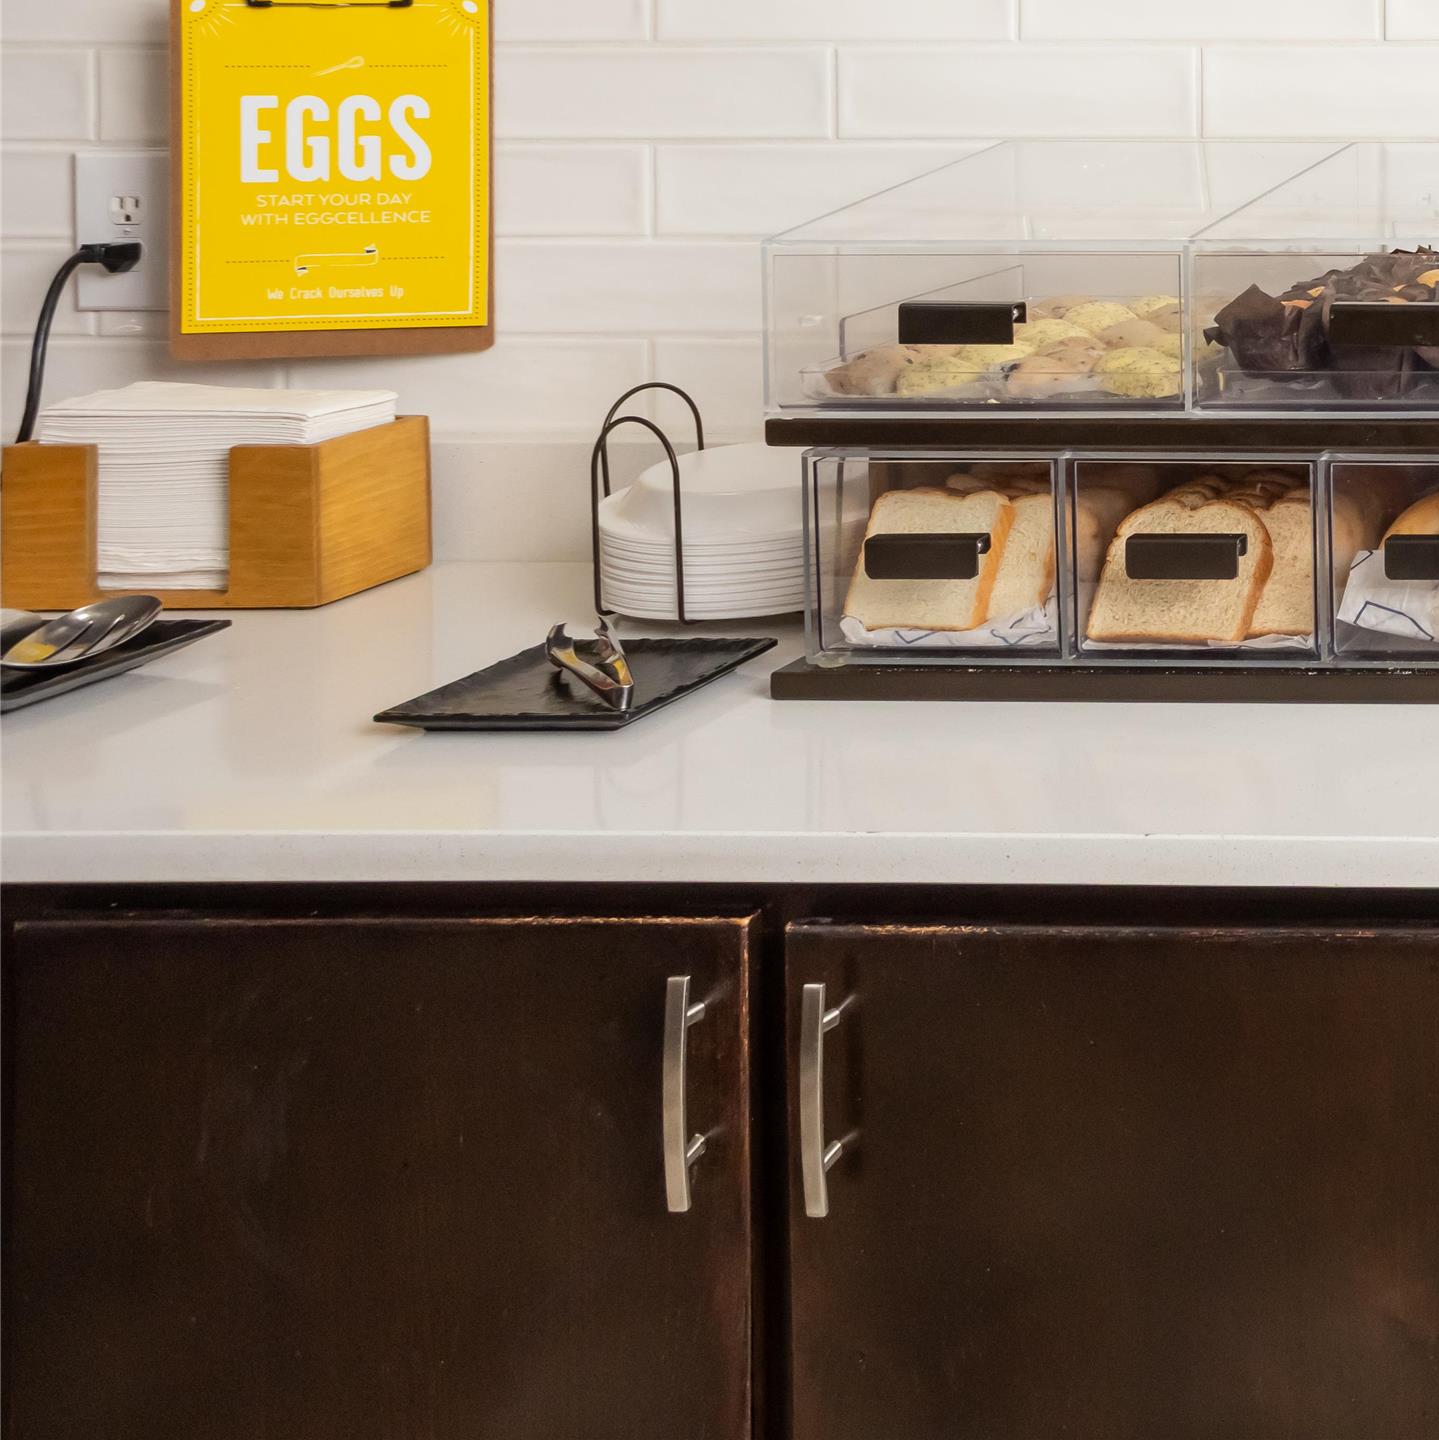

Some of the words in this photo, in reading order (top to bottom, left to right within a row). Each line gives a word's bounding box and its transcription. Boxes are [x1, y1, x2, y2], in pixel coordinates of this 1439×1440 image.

[240, 94, 433, 183] EGGS
[256, 193, 315, 208] START
[318, 193, 371, 207] YOUR
[377, 192, 412, 206] DAY
[240, 213, 288, 226] WITH
[293, 211, 432, 225] EGGCELLENCE
[267, 288, 284, 300] We
[289, 287, 323, 300] Crack
[329, 286, 384, 299] Ourselves
[389, 285, 404, 300] Up
